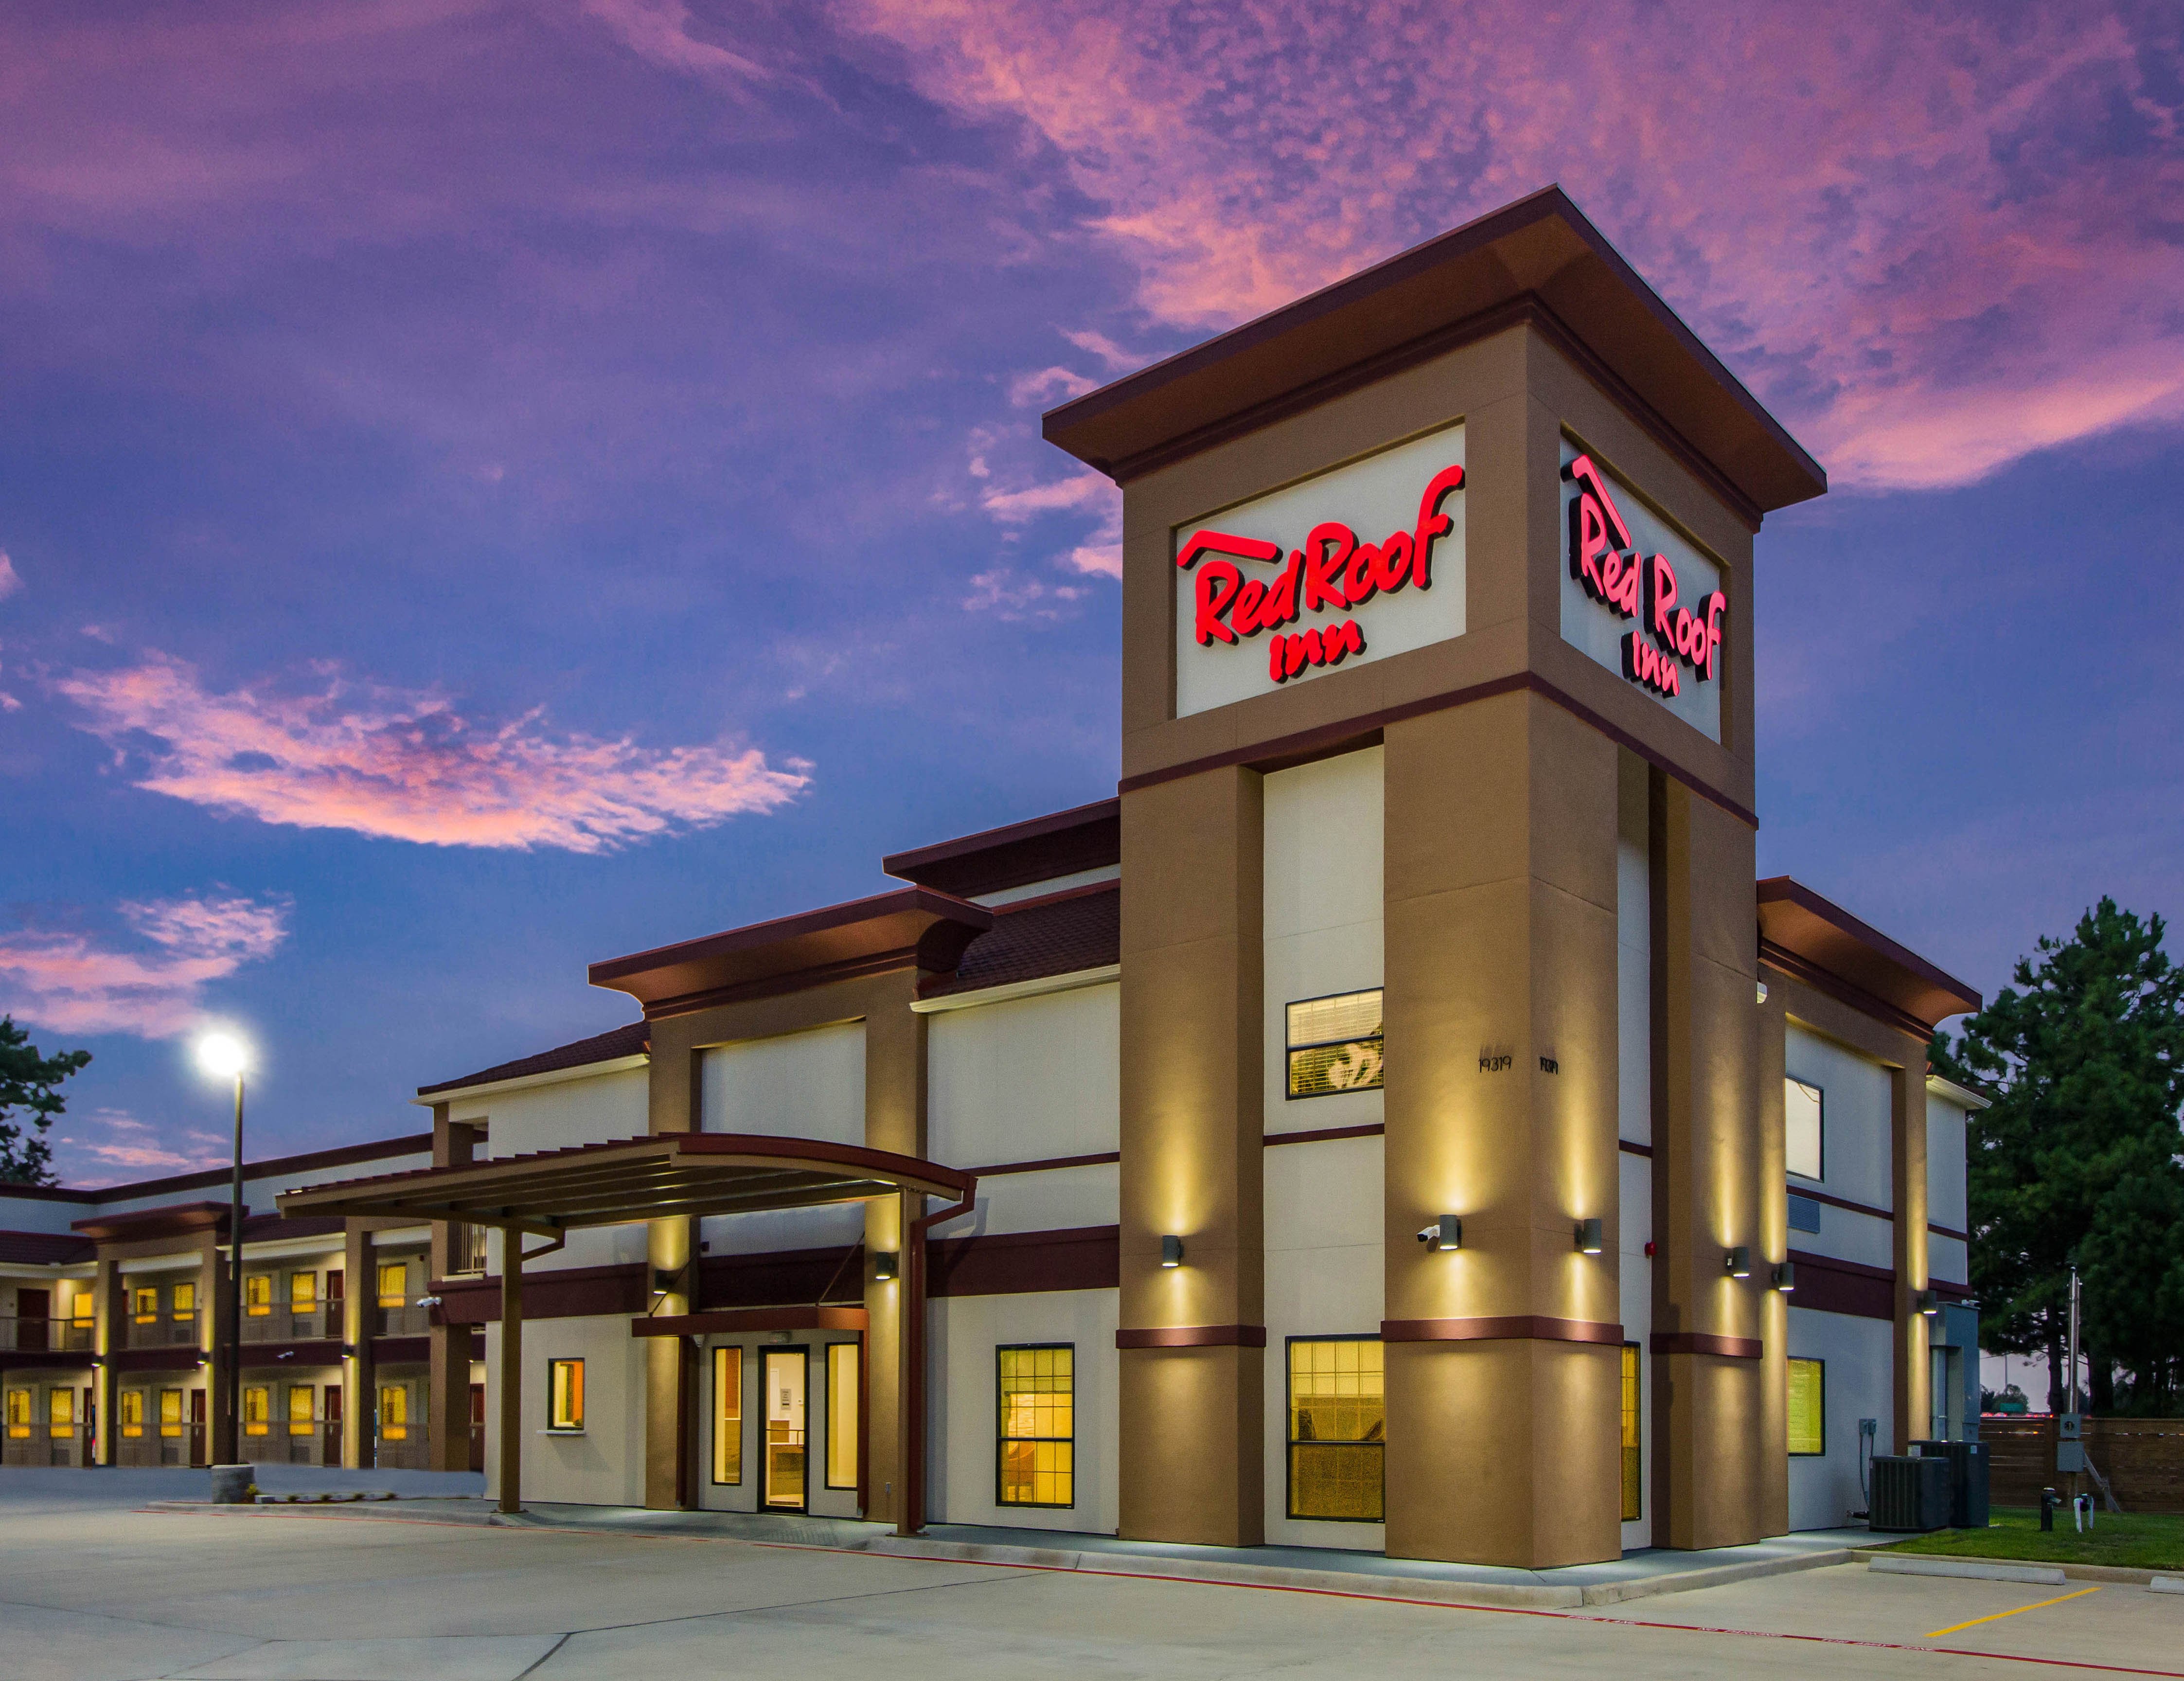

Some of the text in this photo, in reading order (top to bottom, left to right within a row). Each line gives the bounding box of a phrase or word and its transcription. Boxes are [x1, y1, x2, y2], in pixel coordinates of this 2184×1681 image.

[1195, 465, 1463, 645] Red Roof
[1579, 492, 1726, 681] Red Roof
[1478, 1055, 1512, 1073] 19319
